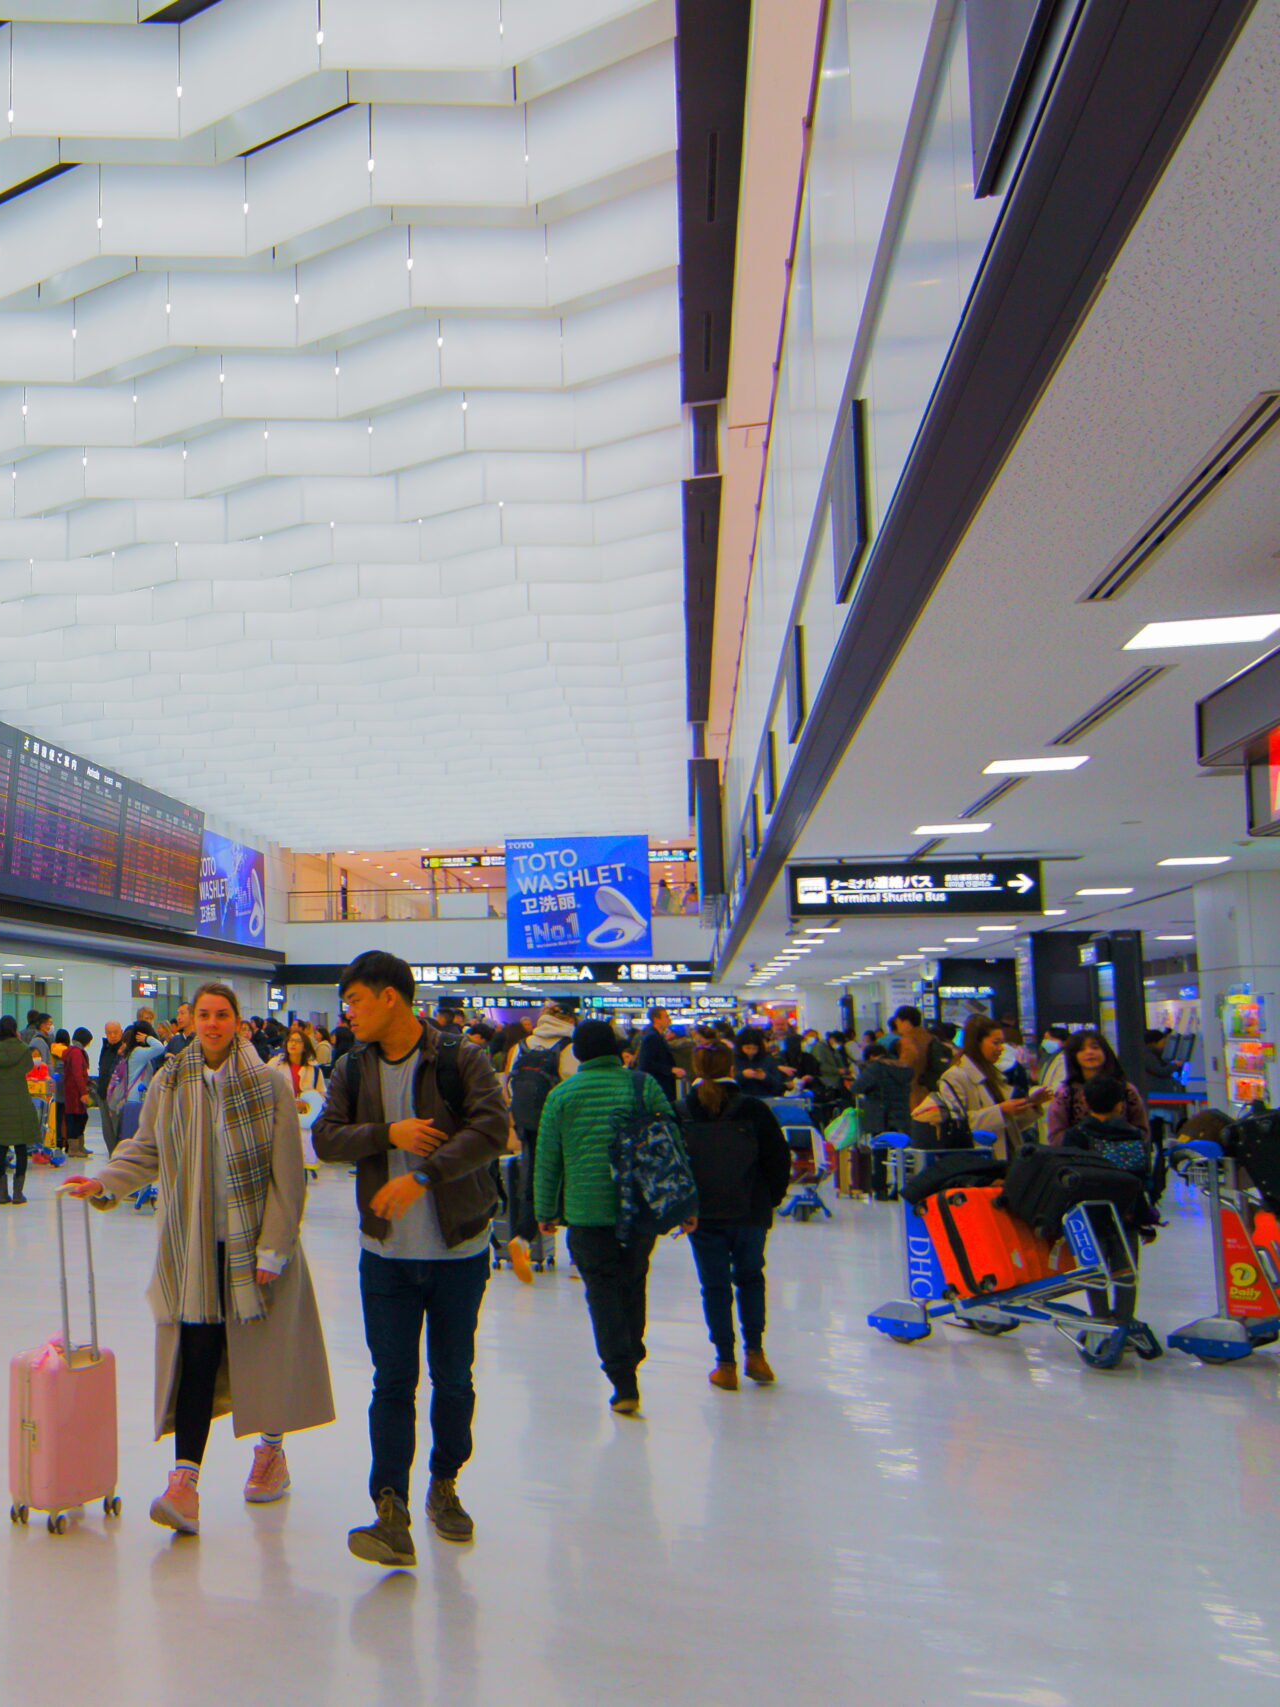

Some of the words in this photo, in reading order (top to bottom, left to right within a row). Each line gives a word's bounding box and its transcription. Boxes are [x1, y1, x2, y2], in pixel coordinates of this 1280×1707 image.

[507, 841, 535, 850] TOTO
[513, 848, 578, 874] TOTO
[830, 874, 933, 890] ターミナル連絡バス
[520, 892, 577, 916] 卫洗丽
[832, 892, 881, 904] Terminal
[882, 891, 924, 903] Shuttle
[925, 891, 946, 902] Bus
[579, 965, 594, 981] A
[1069, 1219, 1097, 1262] DHC
[908, 1235, 933, 1297] DHC
[1230, 1286, 1261, 1300] Daily
